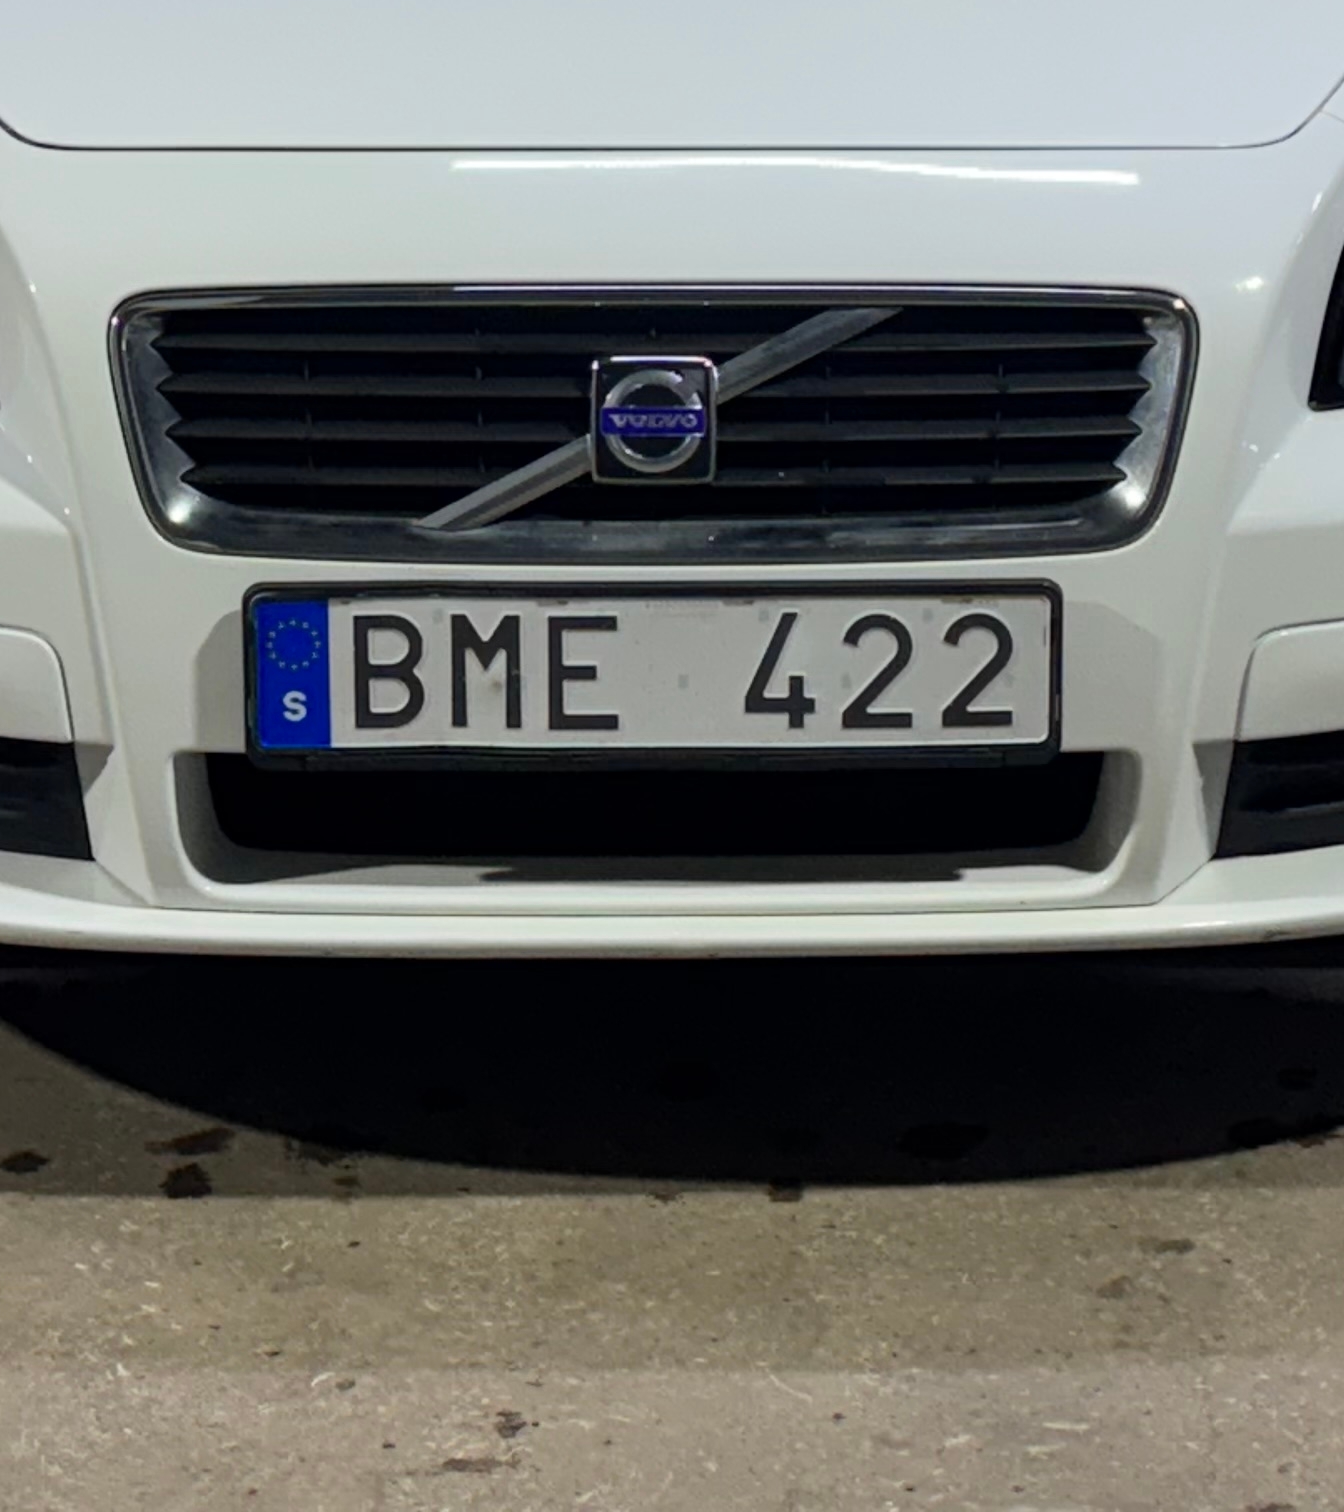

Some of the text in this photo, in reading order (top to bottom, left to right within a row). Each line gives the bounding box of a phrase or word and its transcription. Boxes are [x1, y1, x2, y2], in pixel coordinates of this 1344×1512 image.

[609, 413, 698, 429] VOLVO
[352, 611, 1014, 731] BME 422
[282, 690, 307, 722] S
